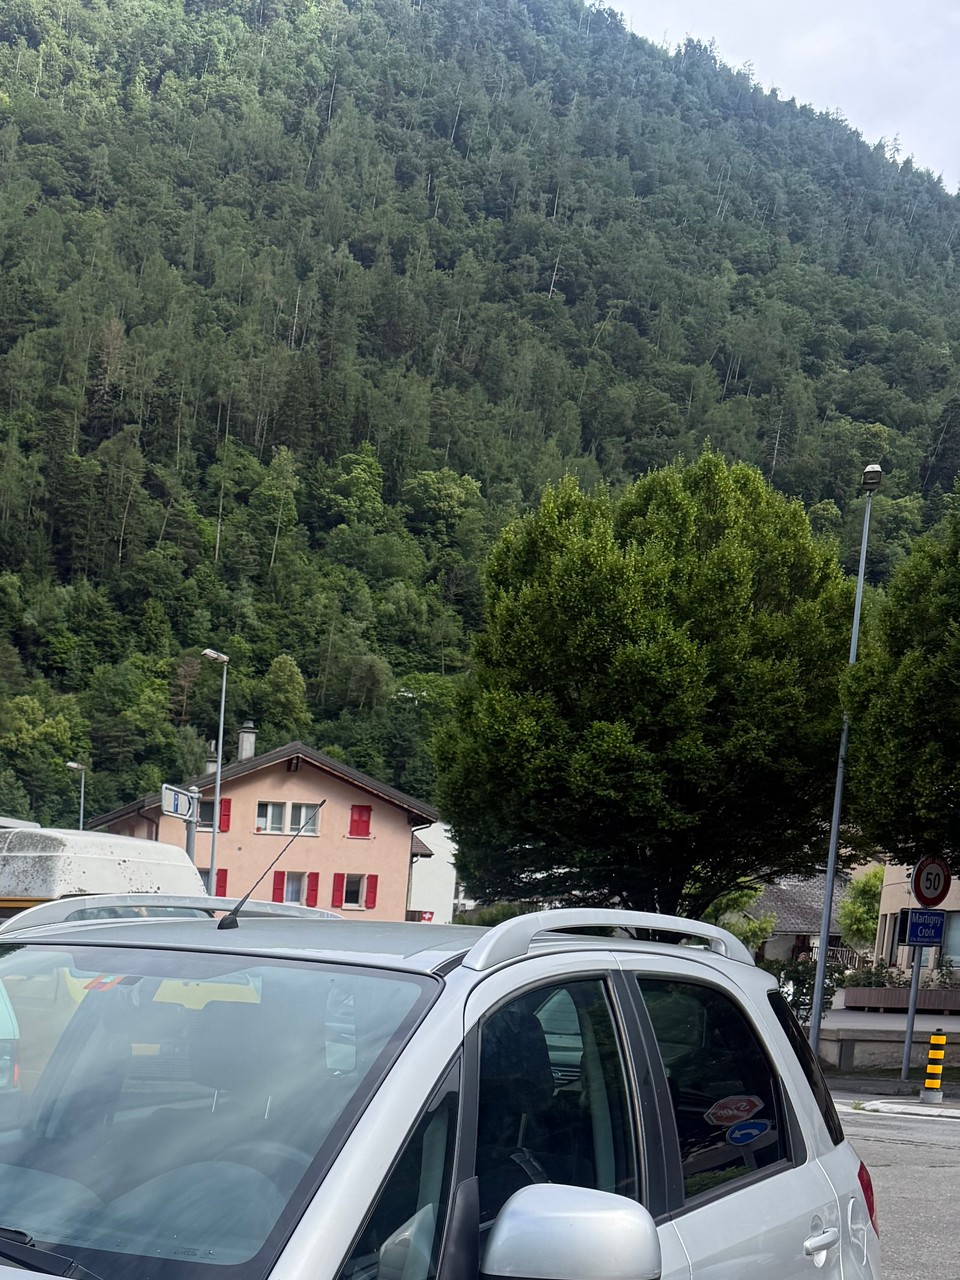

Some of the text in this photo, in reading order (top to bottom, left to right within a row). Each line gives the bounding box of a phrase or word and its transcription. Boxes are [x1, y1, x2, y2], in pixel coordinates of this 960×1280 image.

[925, 871, 941, 891] 50
[912, 912, 943, 927] Martigny-
[917, 926, 935, 937] Croix
